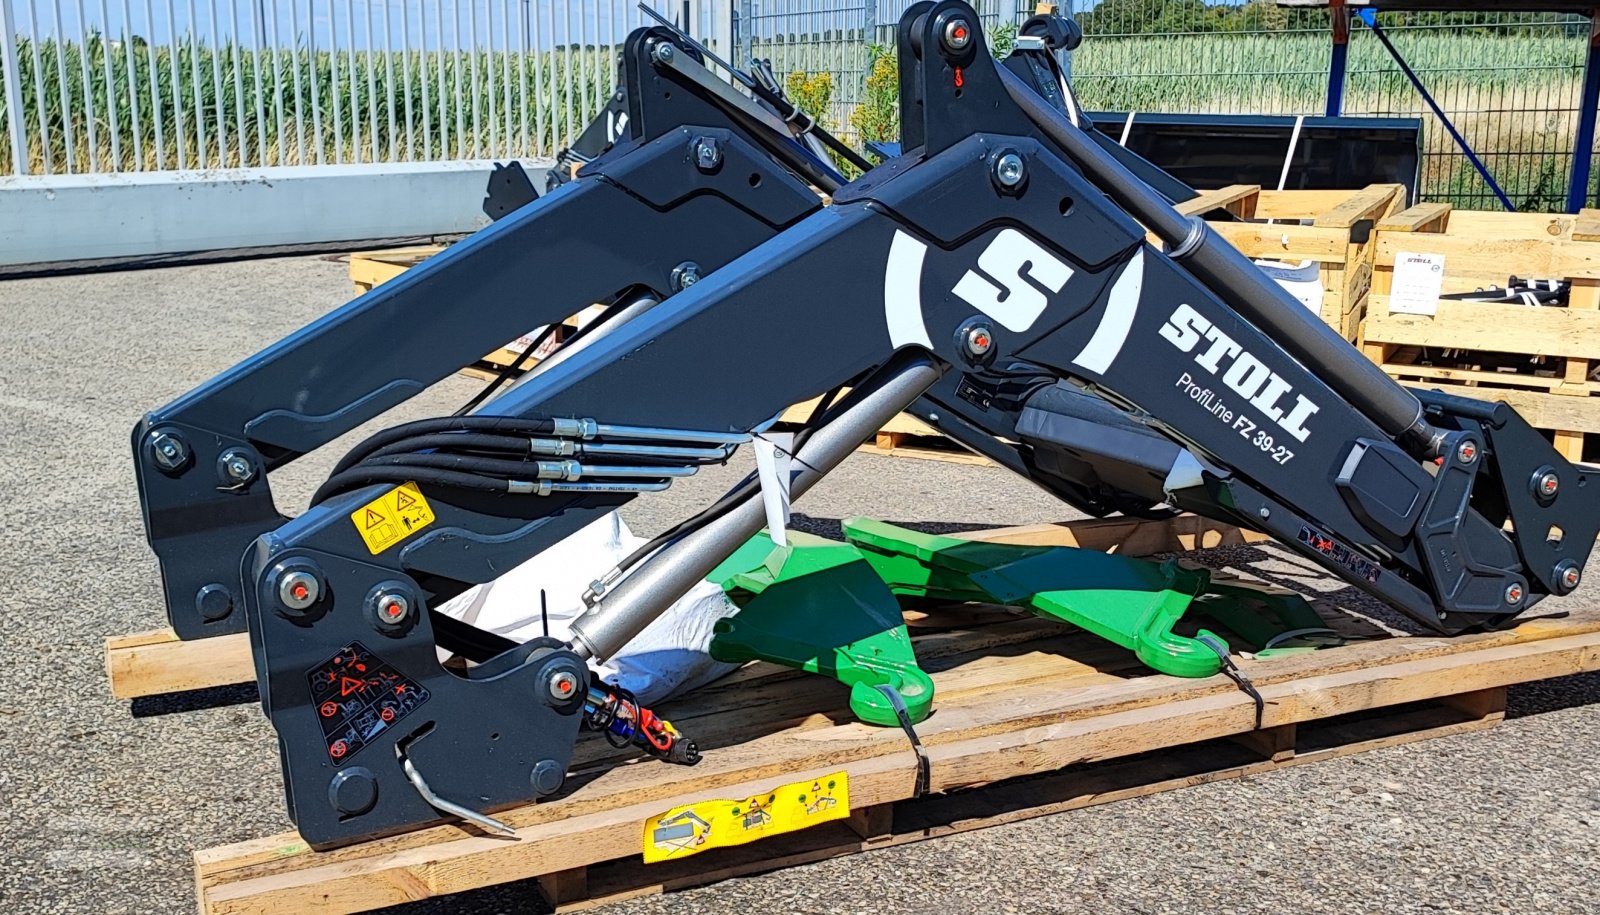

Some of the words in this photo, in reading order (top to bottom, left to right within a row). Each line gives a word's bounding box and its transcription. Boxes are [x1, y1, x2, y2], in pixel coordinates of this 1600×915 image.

[951, 229, 1075, 332] S
[1158, 303, 1320, 443] STOLL
[1175, 372, 1233, 423] ProfiLine
[1232, 414, 1257, 439] FZ
[1252, 430, 1295, 465] 39-27
